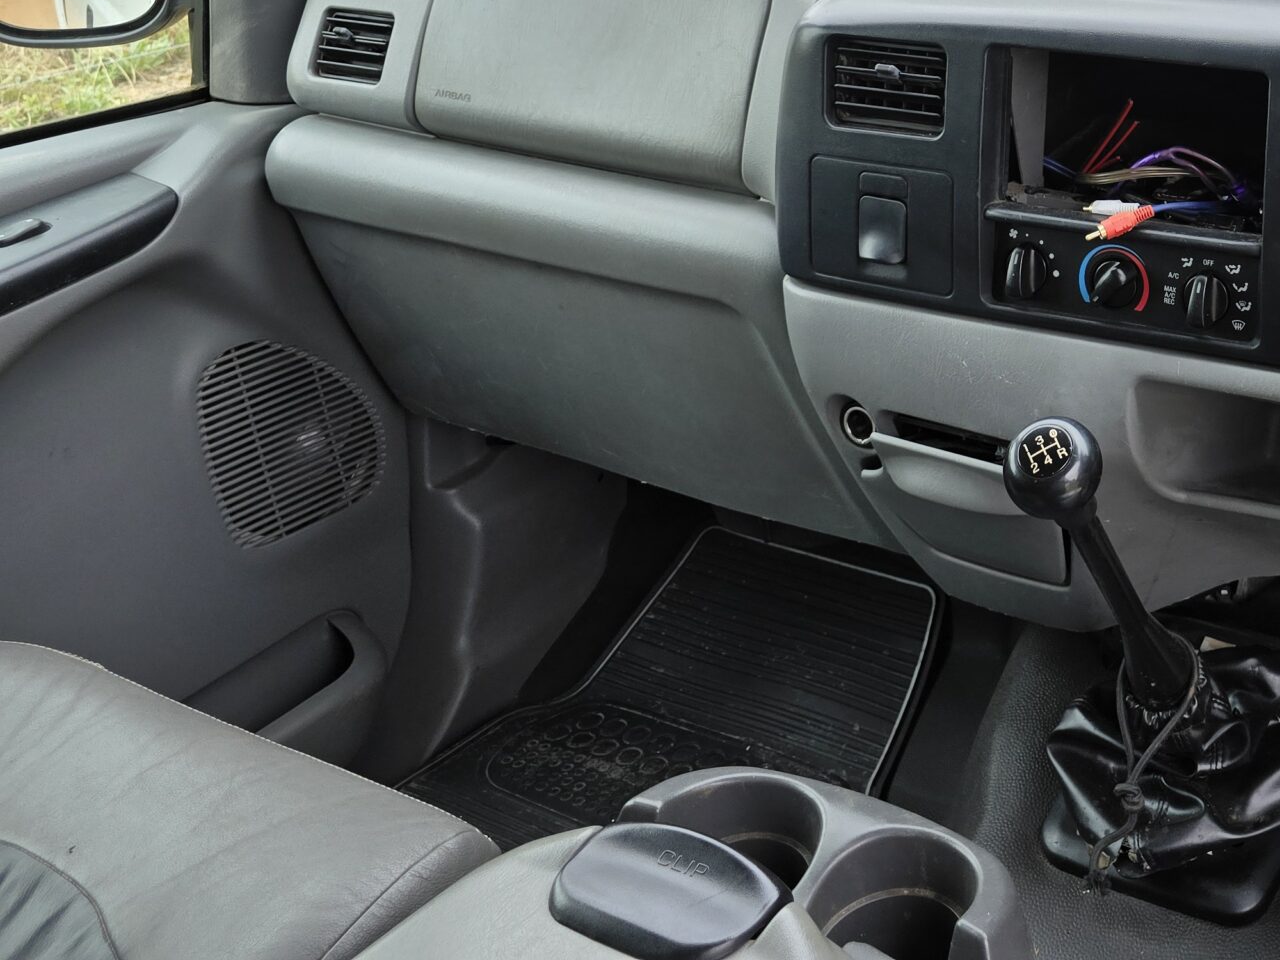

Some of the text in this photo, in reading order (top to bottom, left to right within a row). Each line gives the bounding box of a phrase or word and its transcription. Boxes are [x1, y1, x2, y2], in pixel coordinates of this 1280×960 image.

[434, 89, 472, 103] AIRBAG
[1202, 258, 1215, 267] OFF
[1168, 271, 1180, 280] A/C
[1163, 285, 1177, 293] MAX
[1164, 291, 1176, 299] A/C
[1163, 297, 1175, 306] REC
[1035, 435, 1045, 446] 3
[1056, 447, 1069, 459] R
[1044, 454, 1053, 465] 4
[1030, 462, 1040, 474] 2
[657, 849, 710, 878] CLIP
